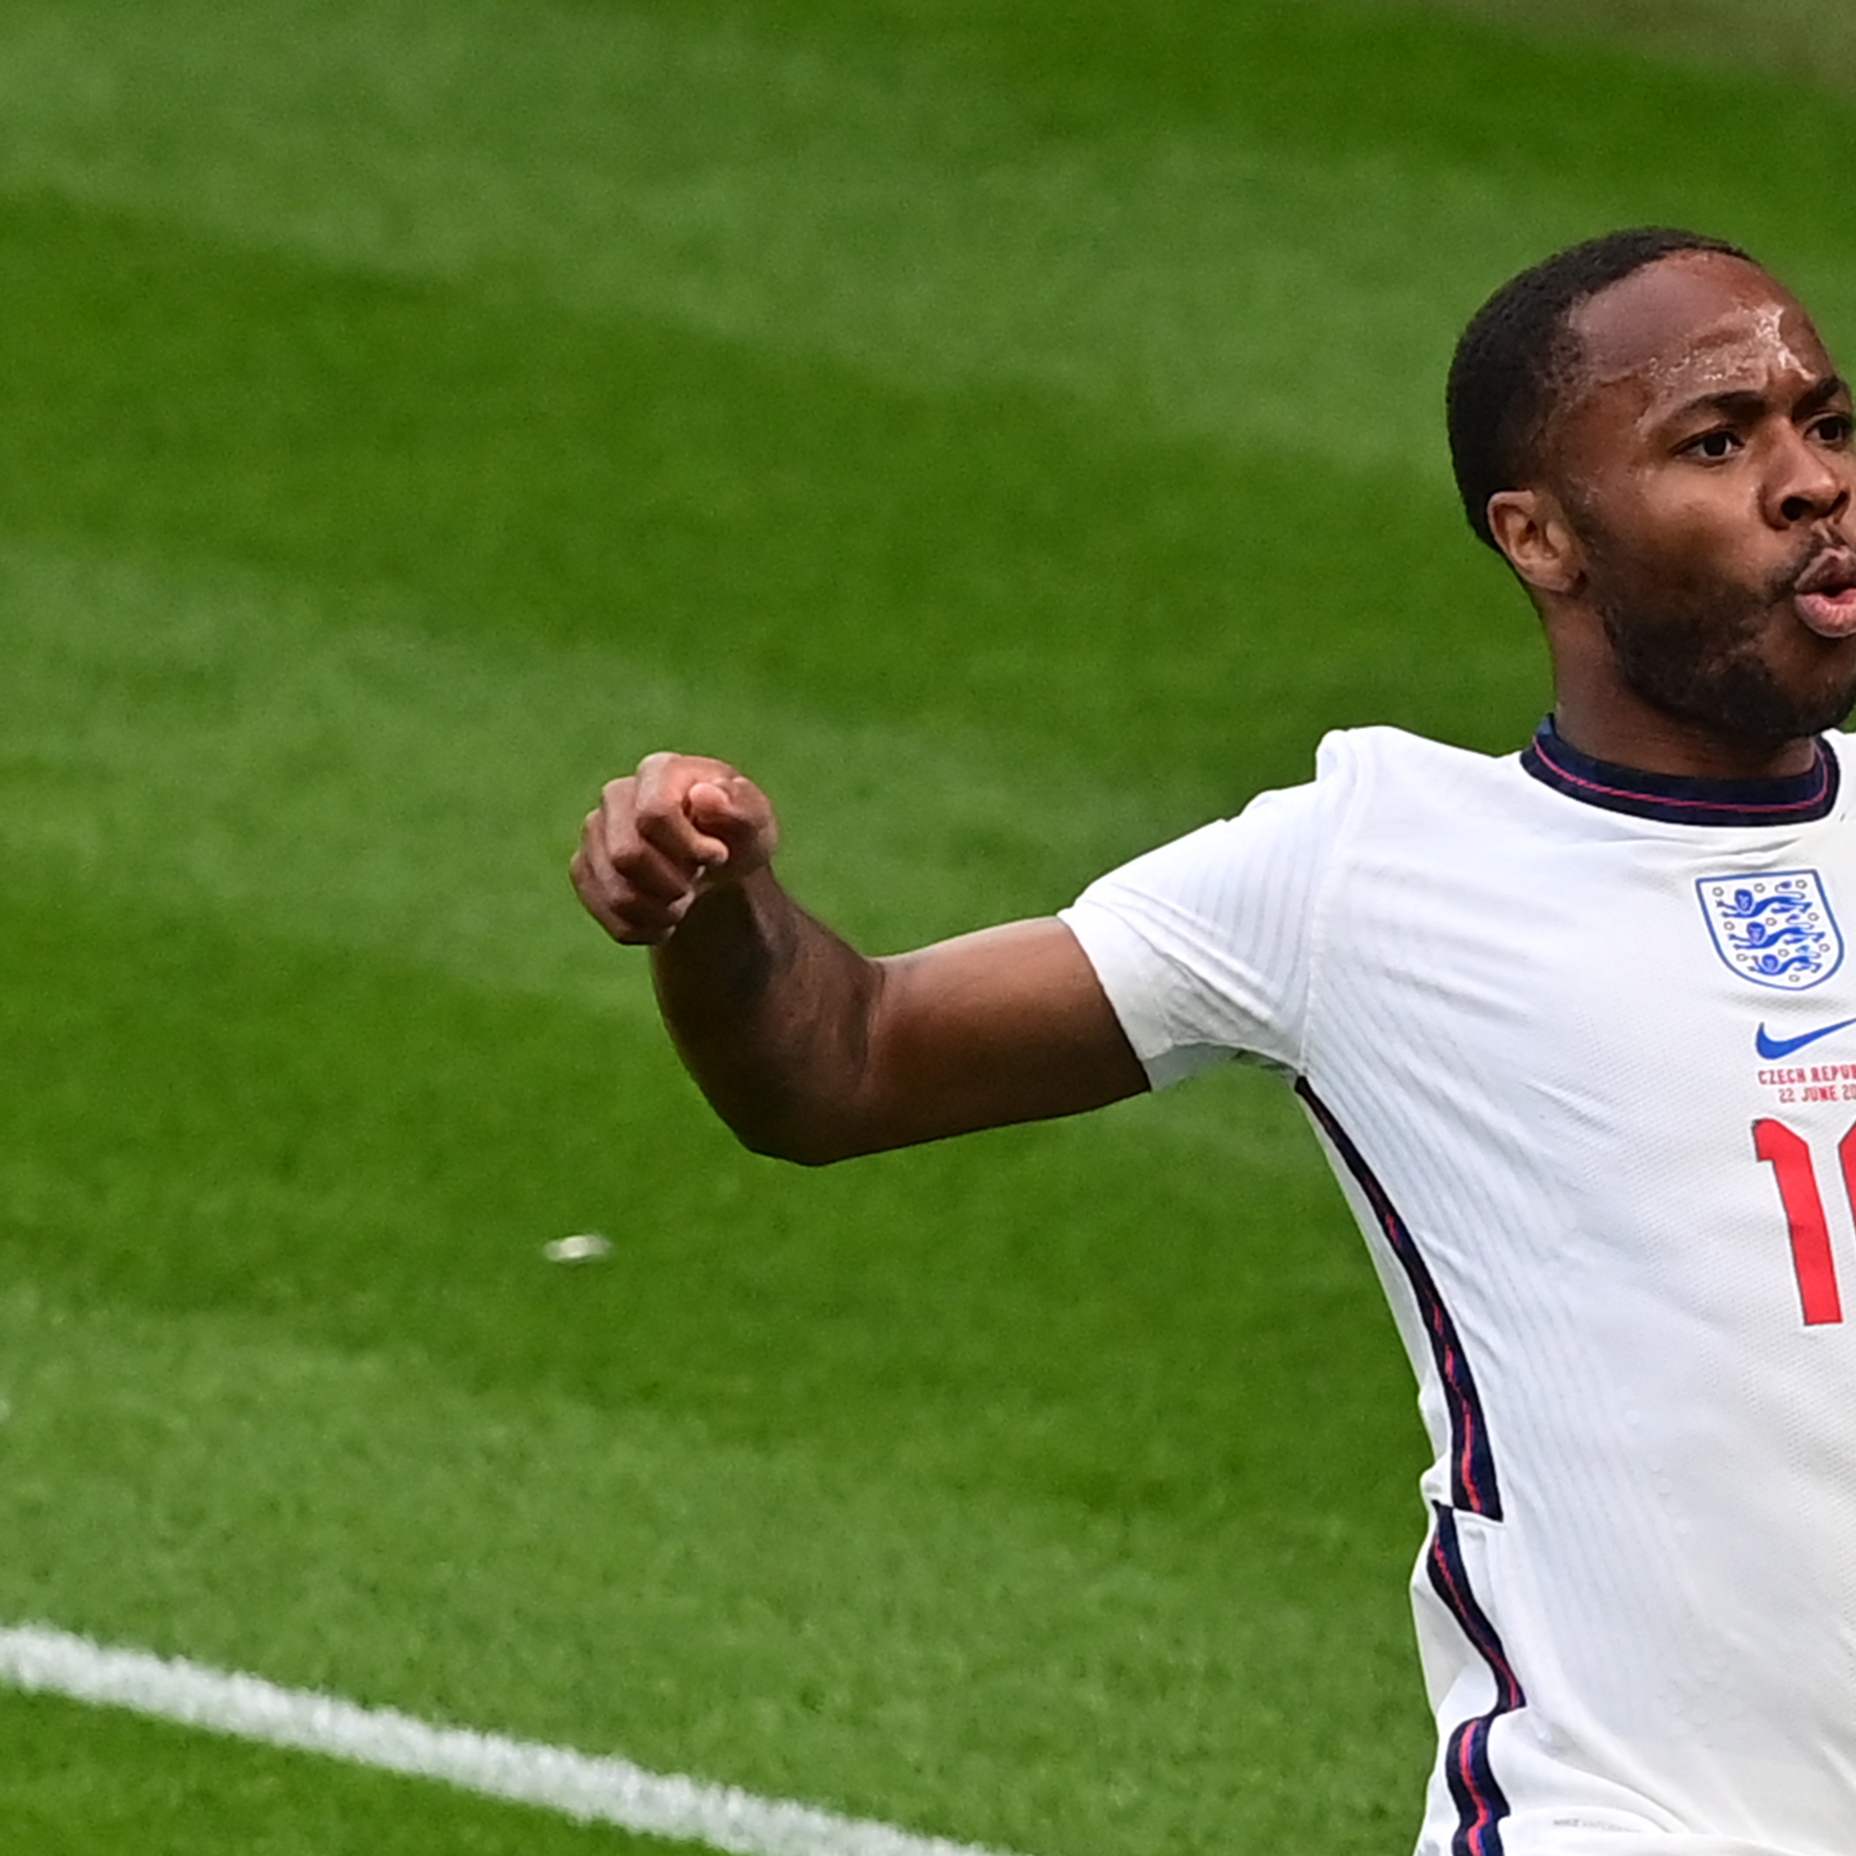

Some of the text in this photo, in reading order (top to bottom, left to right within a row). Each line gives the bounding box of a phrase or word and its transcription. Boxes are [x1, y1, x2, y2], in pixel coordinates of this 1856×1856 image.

[1758, 1068, 1807, 1085] CZECH
[1779, 1087, 1796, 1103] 22
[1801, 1085, 1838, 1102] JUNE
